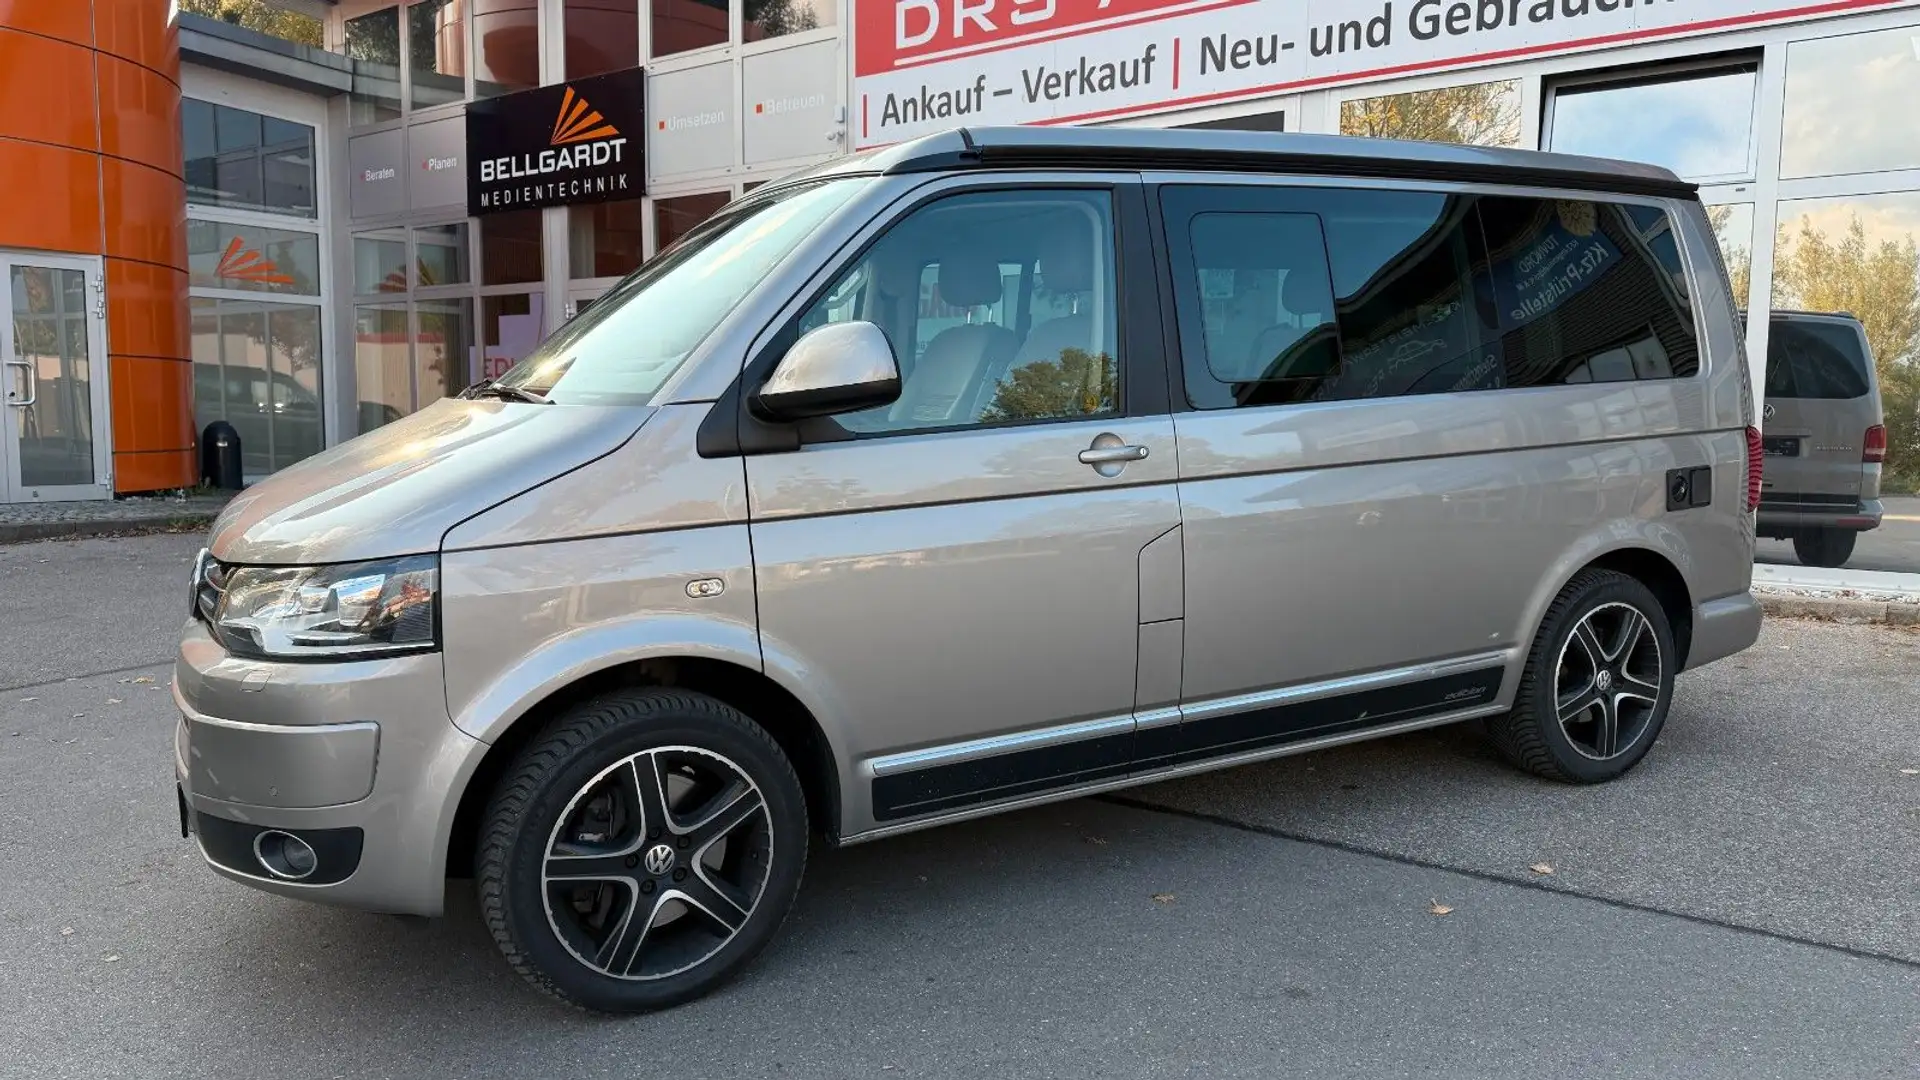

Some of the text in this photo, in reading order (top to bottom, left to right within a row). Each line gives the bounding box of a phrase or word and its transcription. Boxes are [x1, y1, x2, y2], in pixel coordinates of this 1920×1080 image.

[1200, 33, 1295, 75] Neu-
[1310, 2, 1392, 57] und
[881, 74, 986, 127] Ankauf
[1022, 43, 1157, 104] Verkauf
[767, 94, 826, 115] Betreuen
[668, 109, 725, 131] Umsetzen
[428, 157, 457, 171] Planen
[480, 138, 627, 182] BELLGARDT
[365, 168, 395, 181] Beraten
[480, 173, 628, 207] MEDIENTECHNIK
